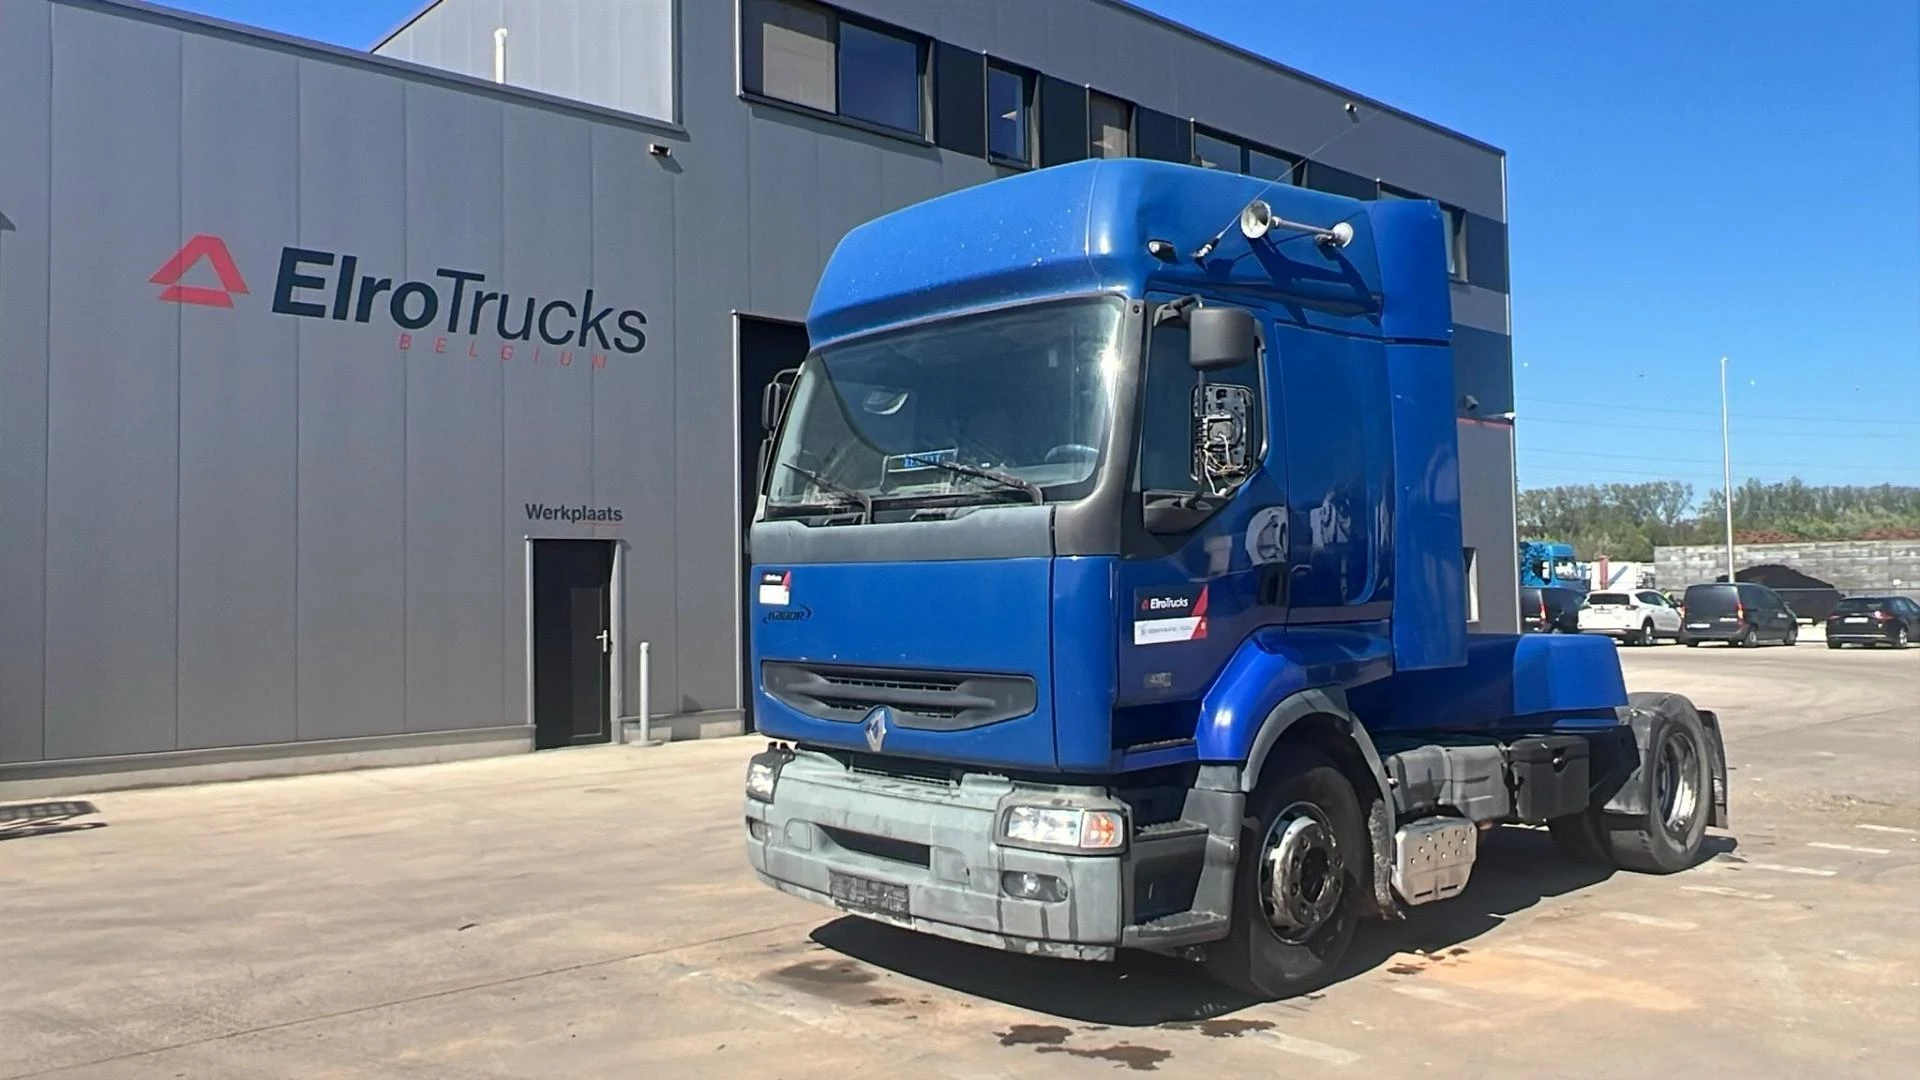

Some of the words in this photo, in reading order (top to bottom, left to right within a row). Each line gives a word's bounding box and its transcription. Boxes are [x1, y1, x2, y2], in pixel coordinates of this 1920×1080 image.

[272, 247, 647, 354] ElroTrucks
[399, 334, 607, 370] BELGIUM
[525, 503, 623, 524] Werkplaats
[1150, 597, 1189, 609] ElroTrucks
